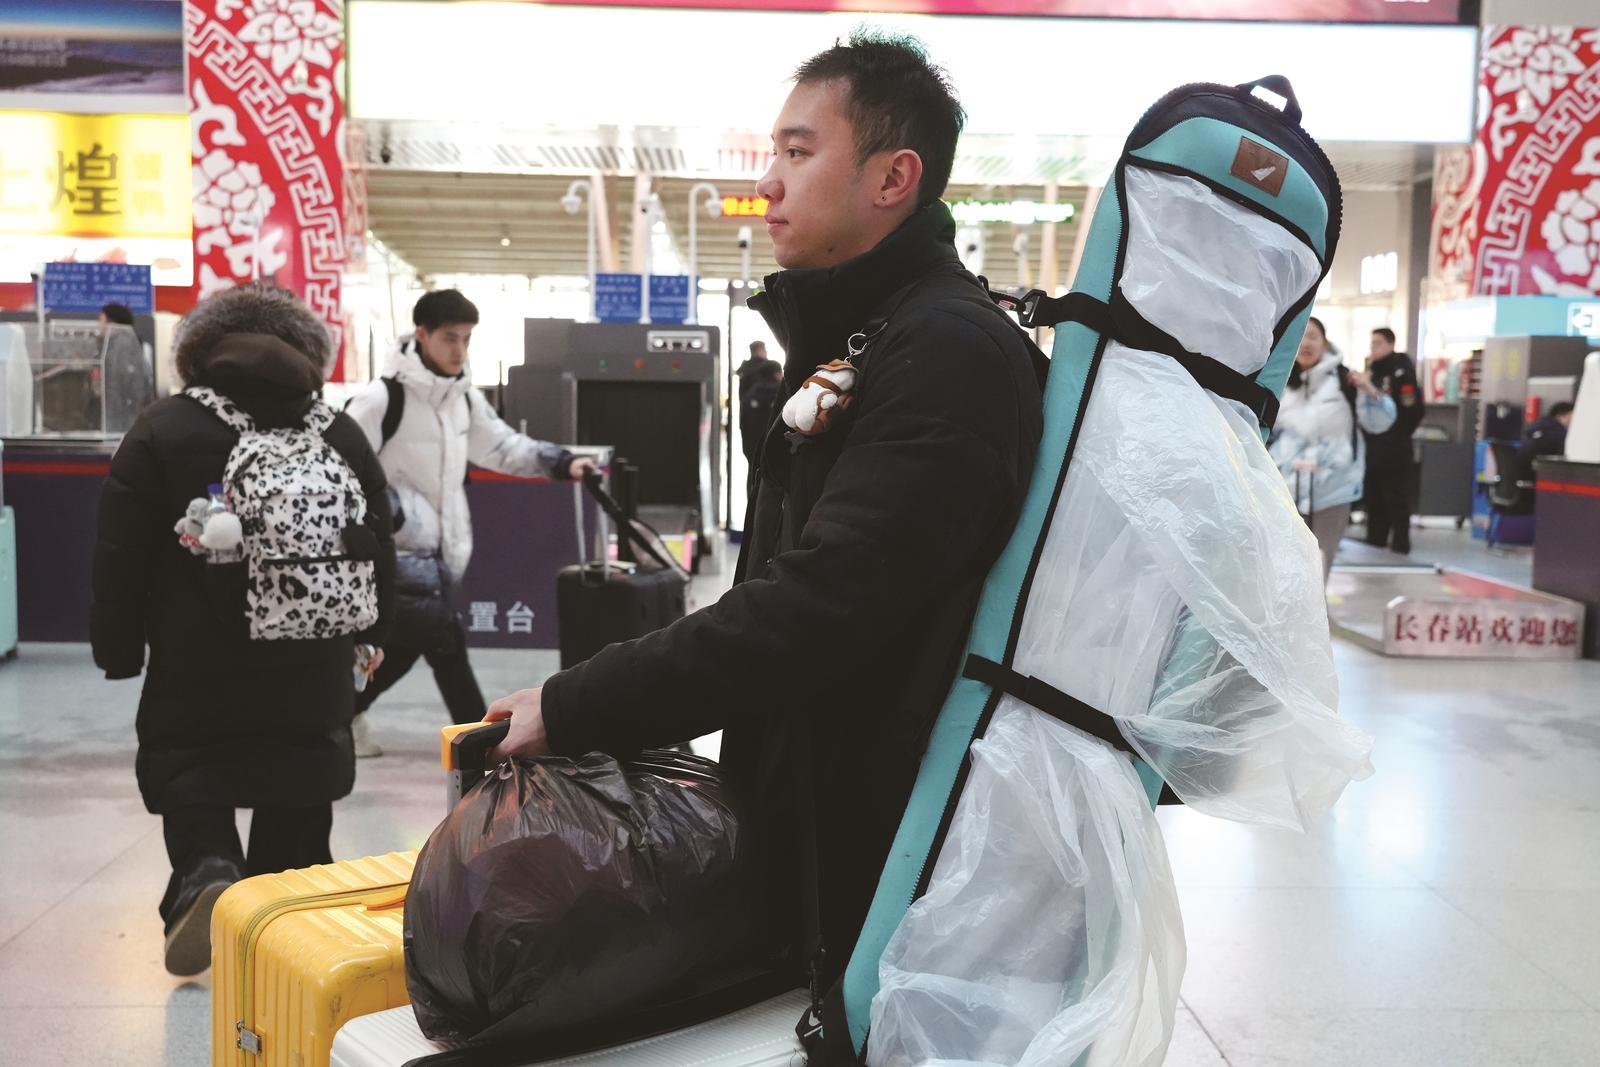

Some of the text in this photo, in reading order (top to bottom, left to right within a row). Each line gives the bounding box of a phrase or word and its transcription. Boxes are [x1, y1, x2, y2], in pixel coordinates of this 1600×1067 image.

[456, 600, 535, 634] 置台
[1394, 613, 1578, 646] 长春站欢迎您
